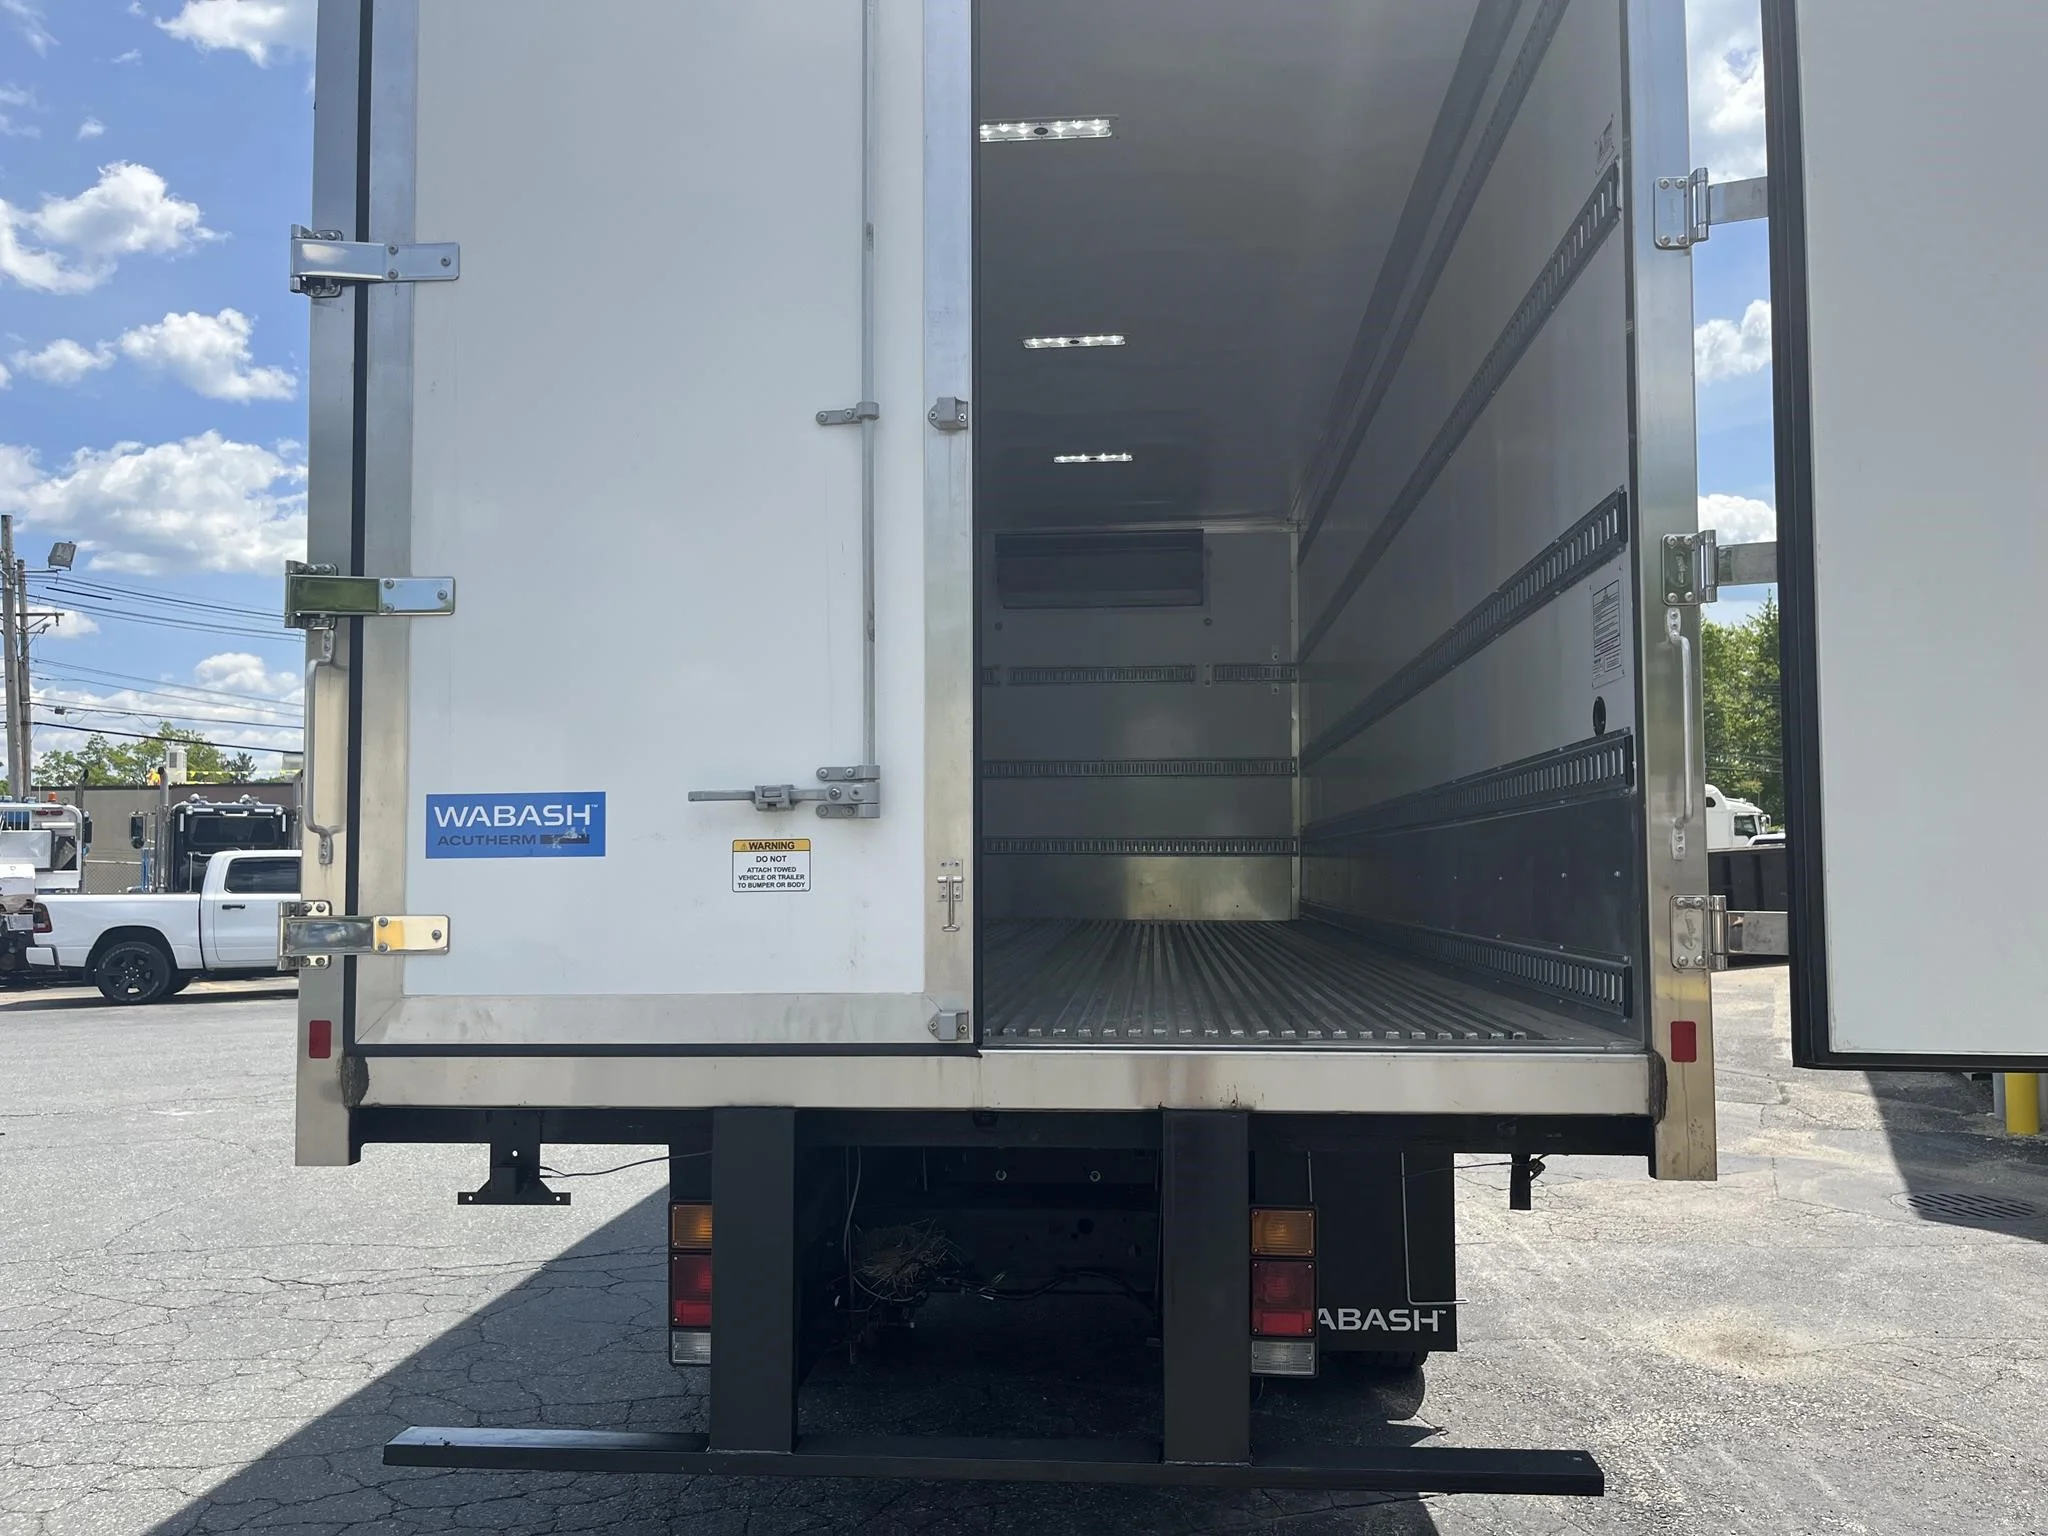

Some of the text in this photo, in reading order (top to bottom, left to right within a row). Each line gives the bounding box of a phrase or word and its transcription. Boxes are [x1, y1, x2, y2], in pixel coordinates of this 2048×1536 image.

[437, 834, 537, 846] ACUTHERM
[748, 841, 795, 850] WARNING
[756, 855, 768, 863] DO
